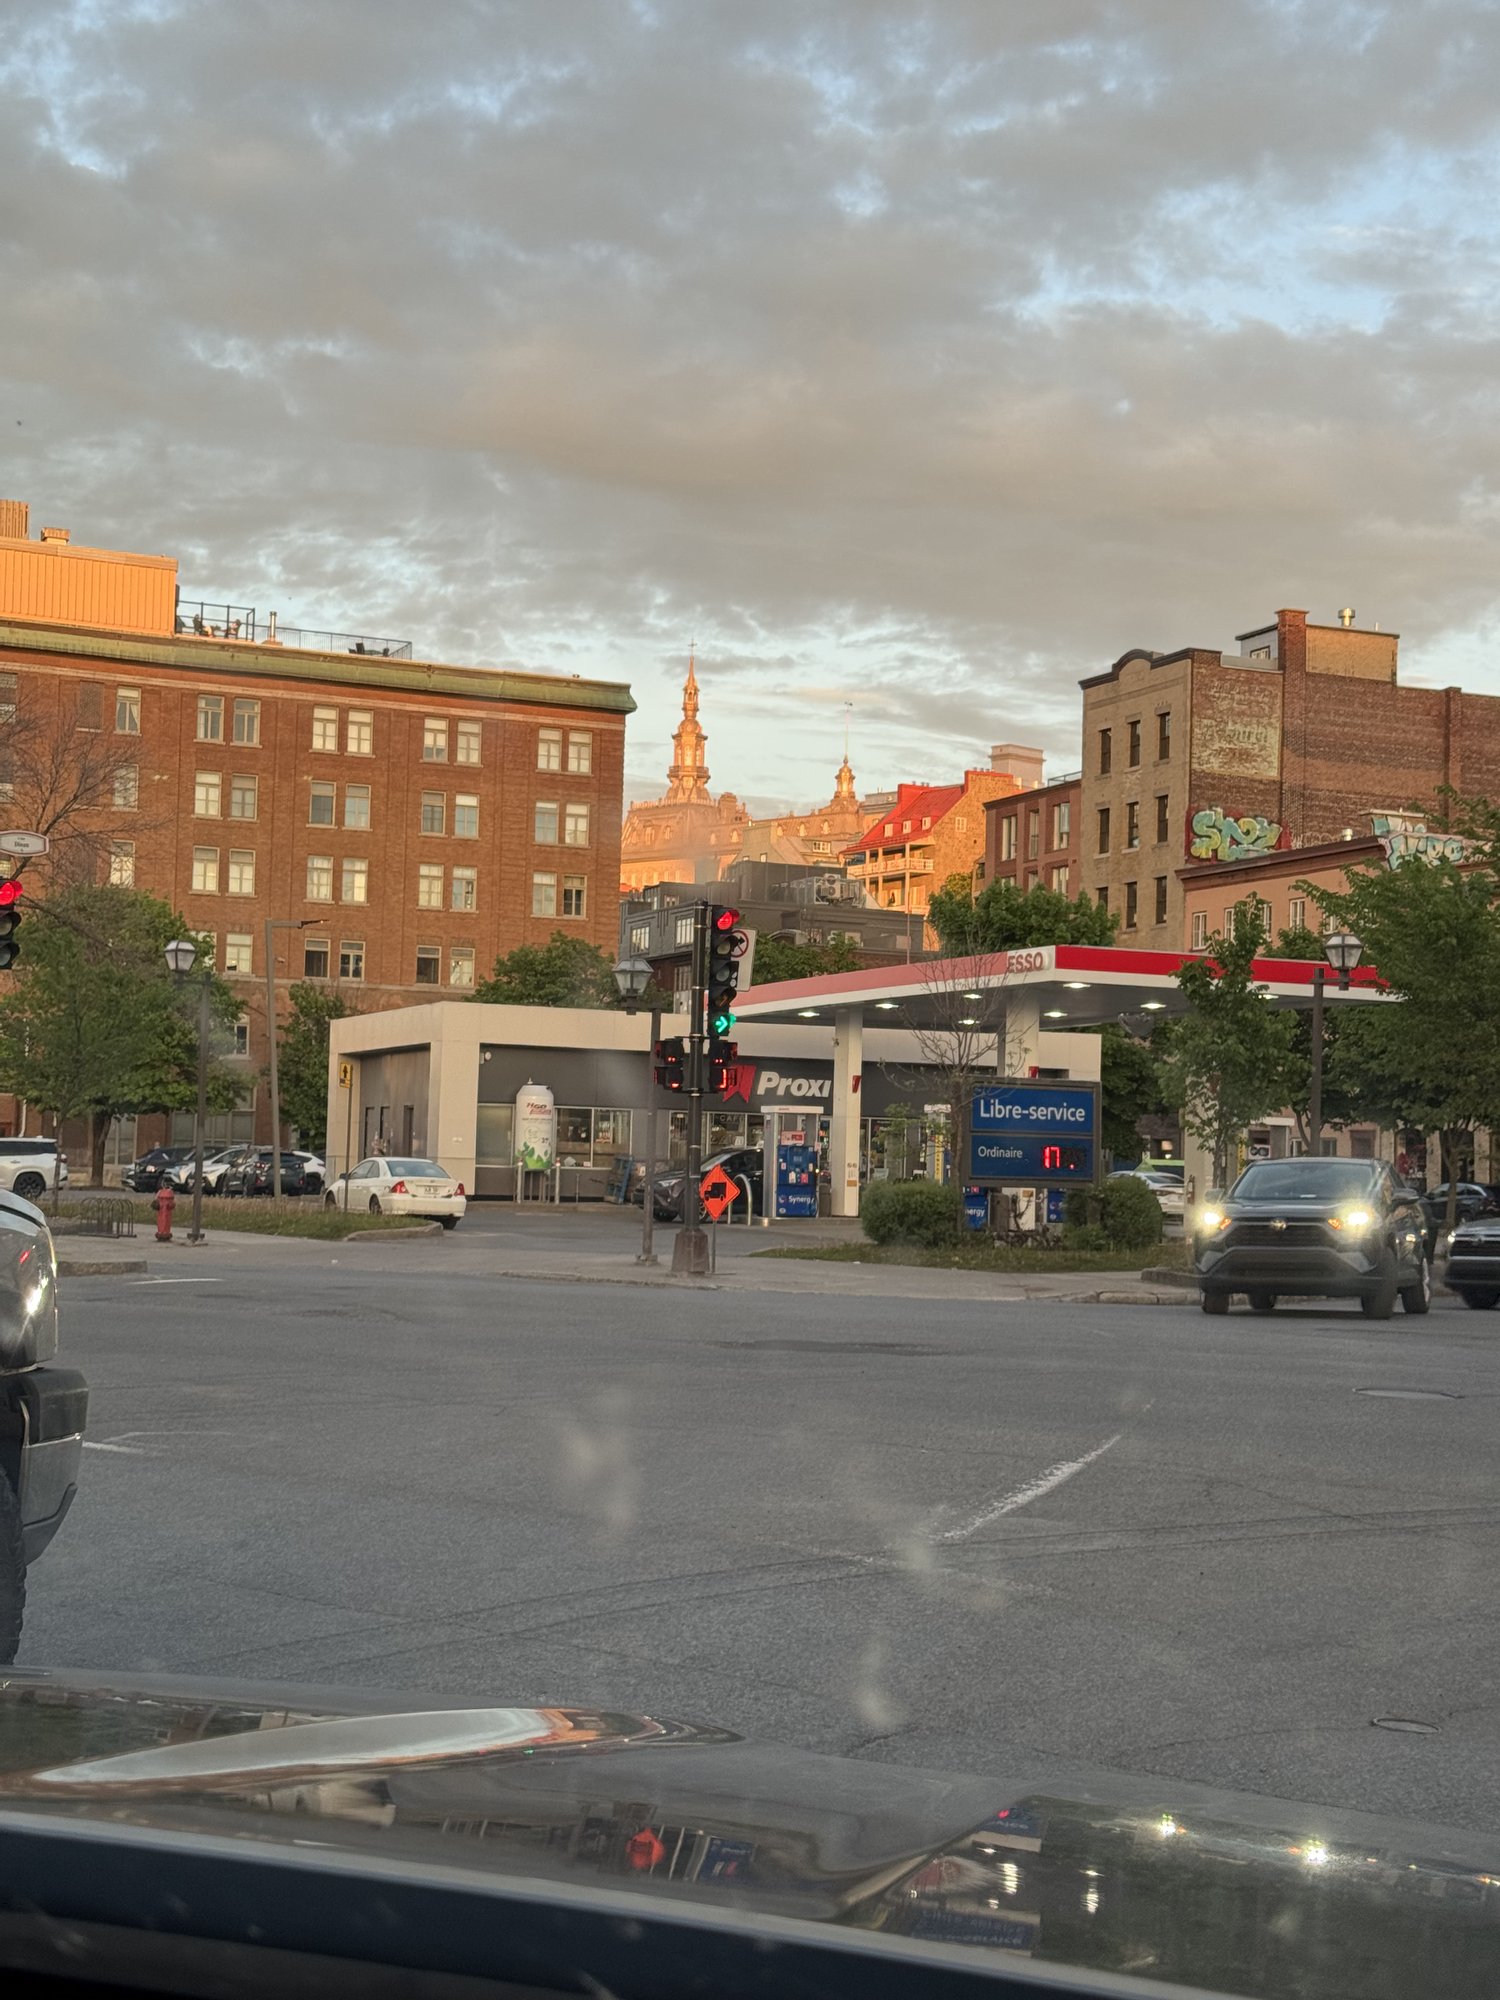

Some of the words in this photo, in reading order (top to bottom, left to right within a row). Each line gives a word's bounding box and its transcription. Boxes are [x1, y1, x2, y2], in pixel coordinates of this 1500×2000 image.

[1007, 952, 1044, 973] ESSO
[757, 1071, 832, 1098] Proxi
[980, 1099, 1085, 1121] Libre-service
[977, 1146, 1023, 1158] Ordinaire
